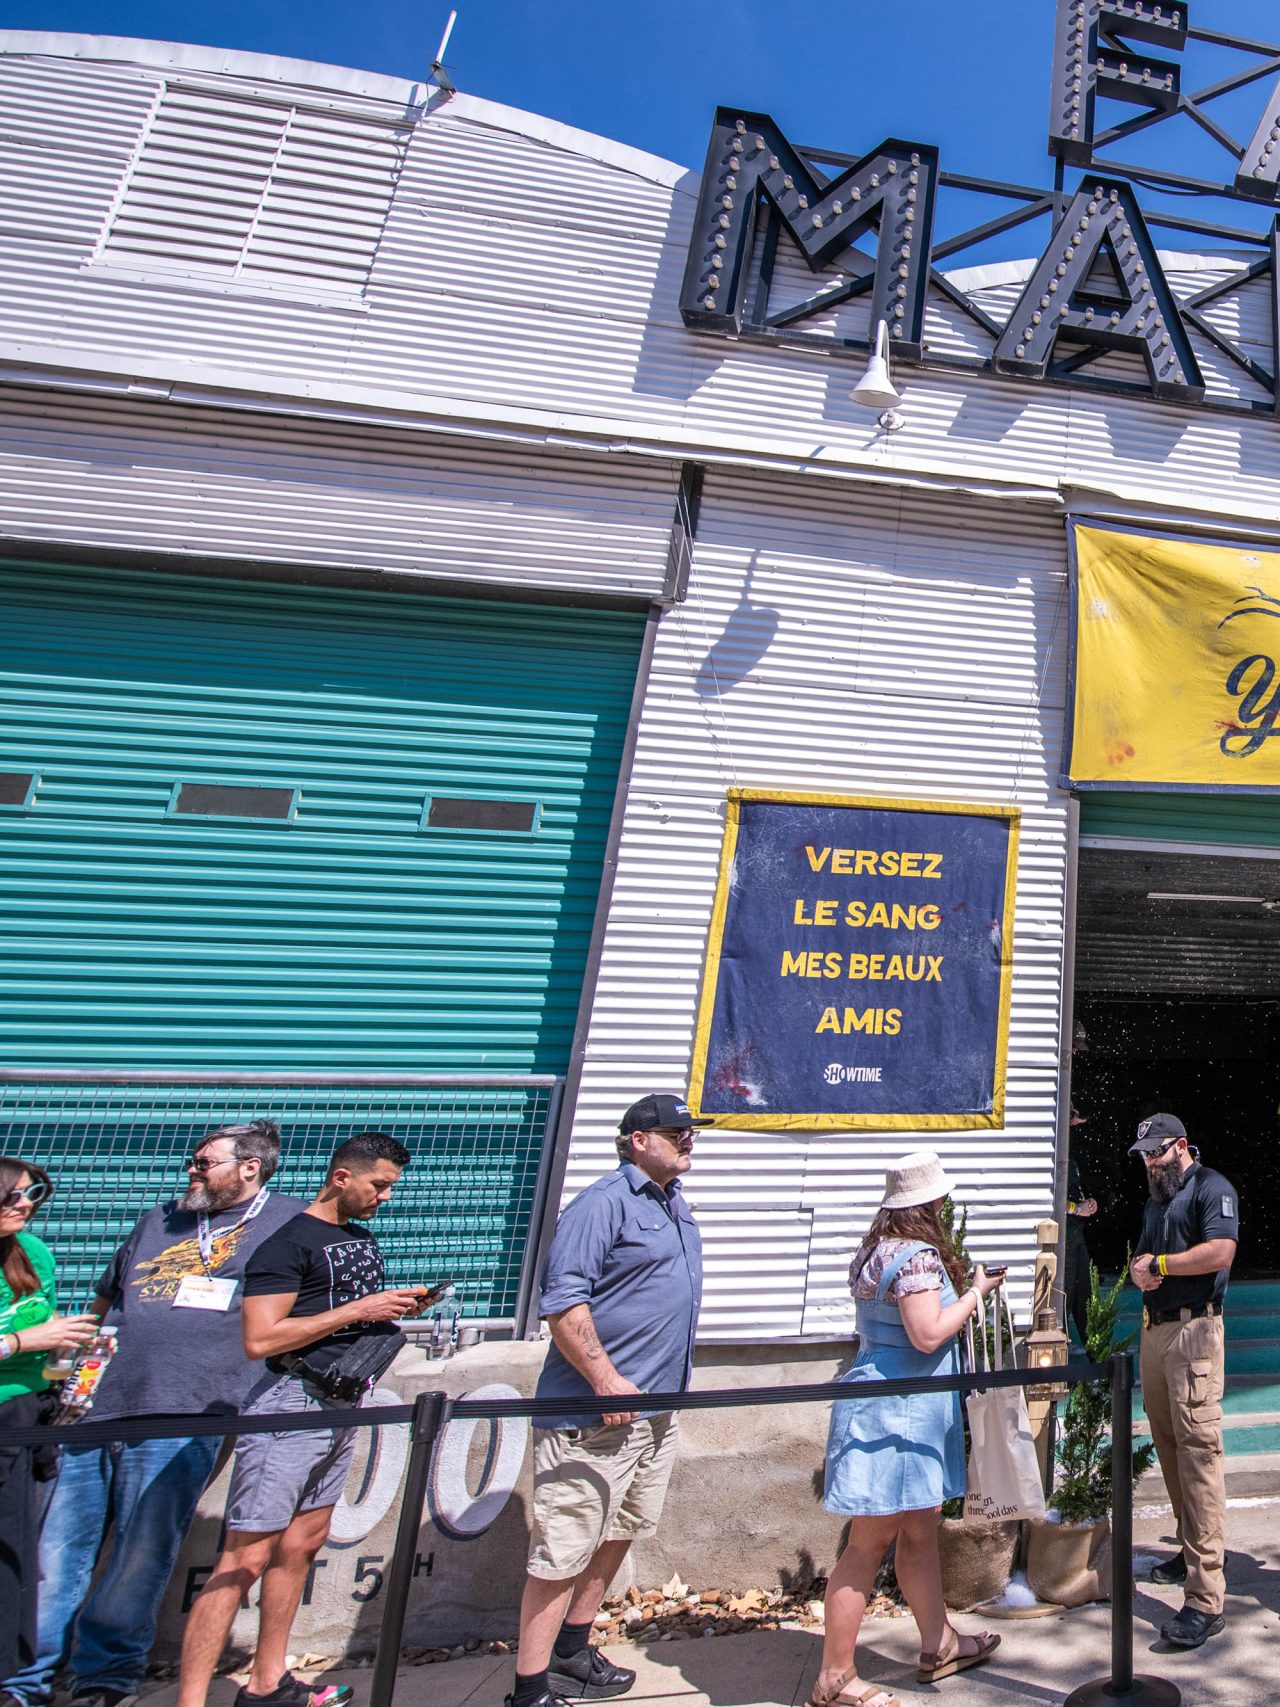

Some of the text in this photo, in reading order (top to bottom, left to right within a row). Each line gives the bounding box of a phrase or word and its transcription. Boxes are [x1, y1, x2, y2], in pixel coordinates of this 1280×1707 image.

[805, 846, 944, 879] VERSEZ
[793, 899, 943, 930] LE SANG
[780, 950, 944, 982] MES BEAUX
[815, 1007, 903, 1035] AMIS
[823, 1062, 883, 1085] SHOWTIME
[139, 1280, 178, 1298] SYR
[1001, 1504, 1019, 1517] days
[181, 1551, 435, 1614] ET 5H
